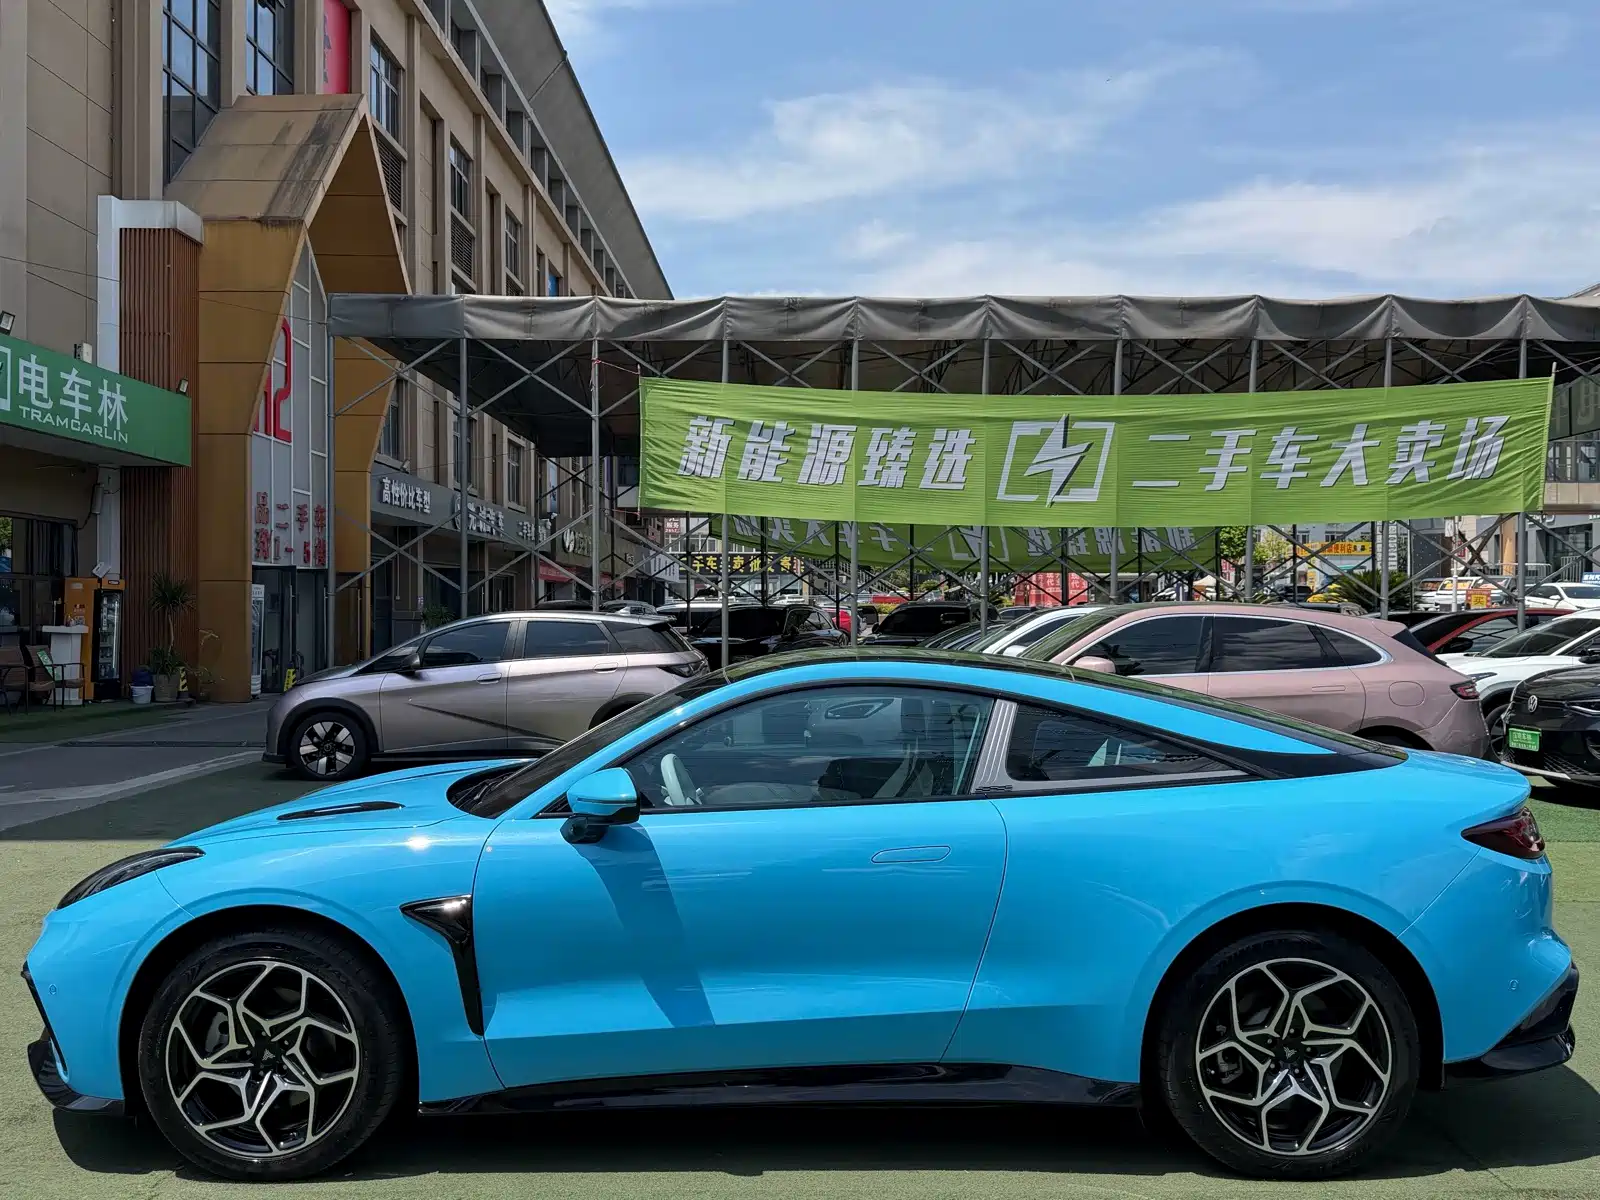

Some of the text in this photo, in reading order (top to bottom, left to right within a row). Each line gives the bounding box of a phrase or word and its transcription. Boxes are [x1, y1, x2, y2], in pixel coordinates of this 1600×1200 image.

[19, 354, 129, 430] 电车林
[19, 405, 129, 444] TRAMCARLIN
[678, 415, 1512, 492] 新能源臻选 二手车大卖场
[382, 477, 431, 514] 高性价比车型
